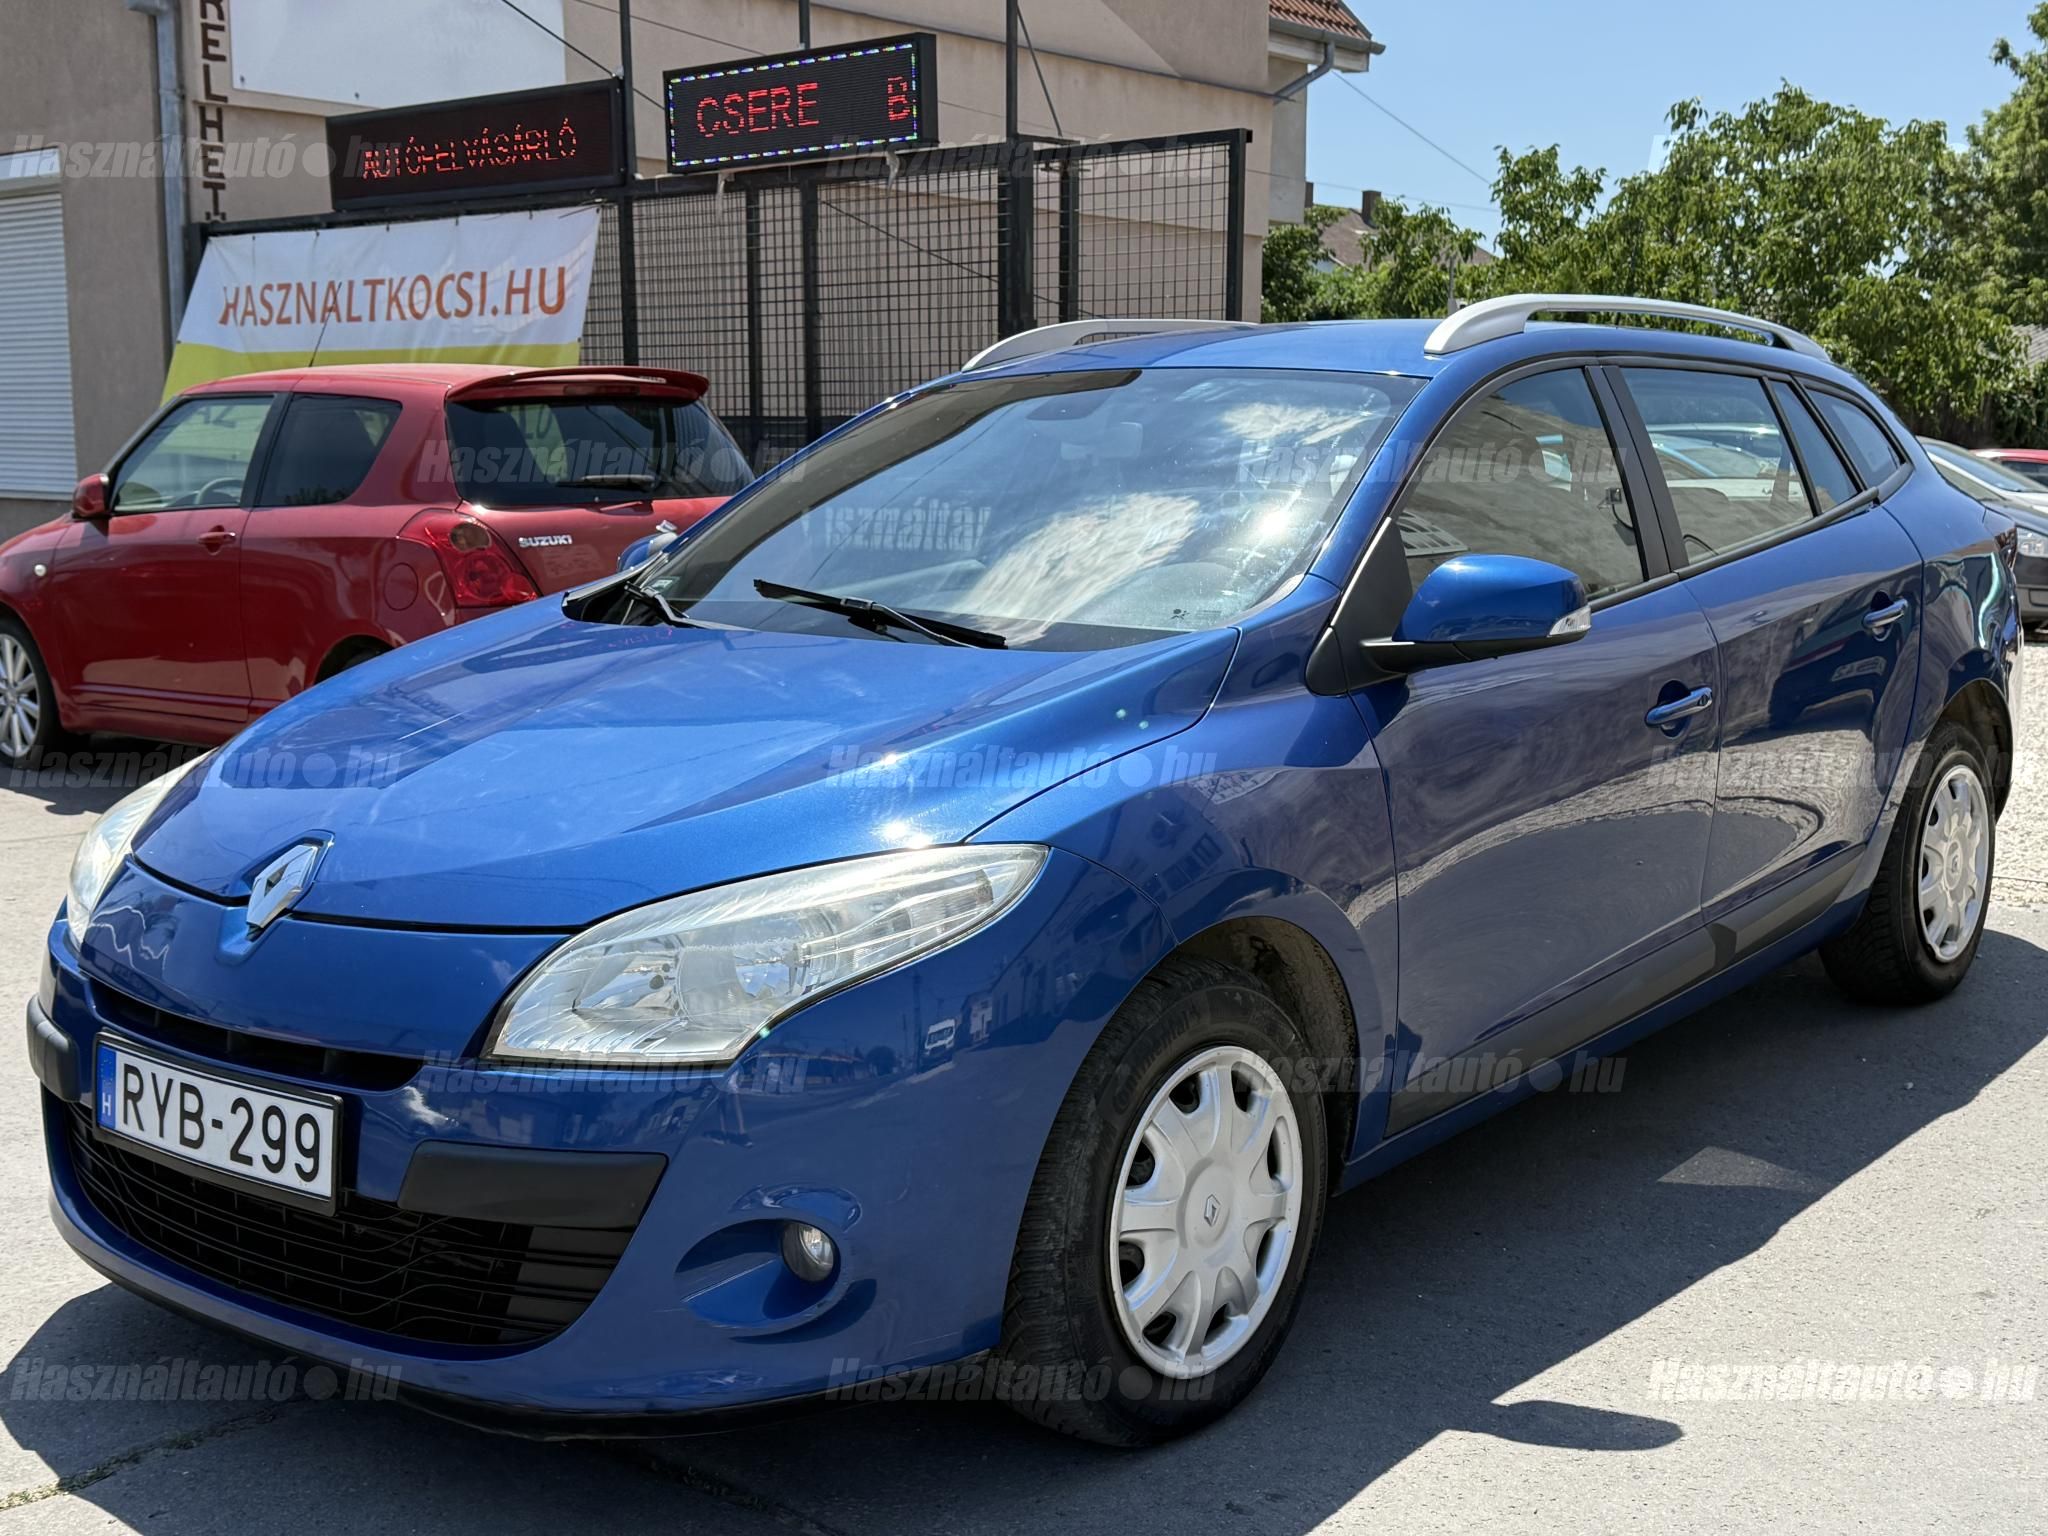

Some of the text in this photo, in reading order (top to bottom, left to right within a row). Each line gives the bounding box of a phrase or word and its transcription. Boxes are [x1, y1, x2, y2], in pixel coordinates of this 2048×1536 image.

[697, 76, 911, 137] CSERE B
[218, 266, 566, 326] HASZNALTKOCSI.HU
[519, 535, 573, 548] SUZUKI
[123, 1063, 321, 1183] RYB-299
